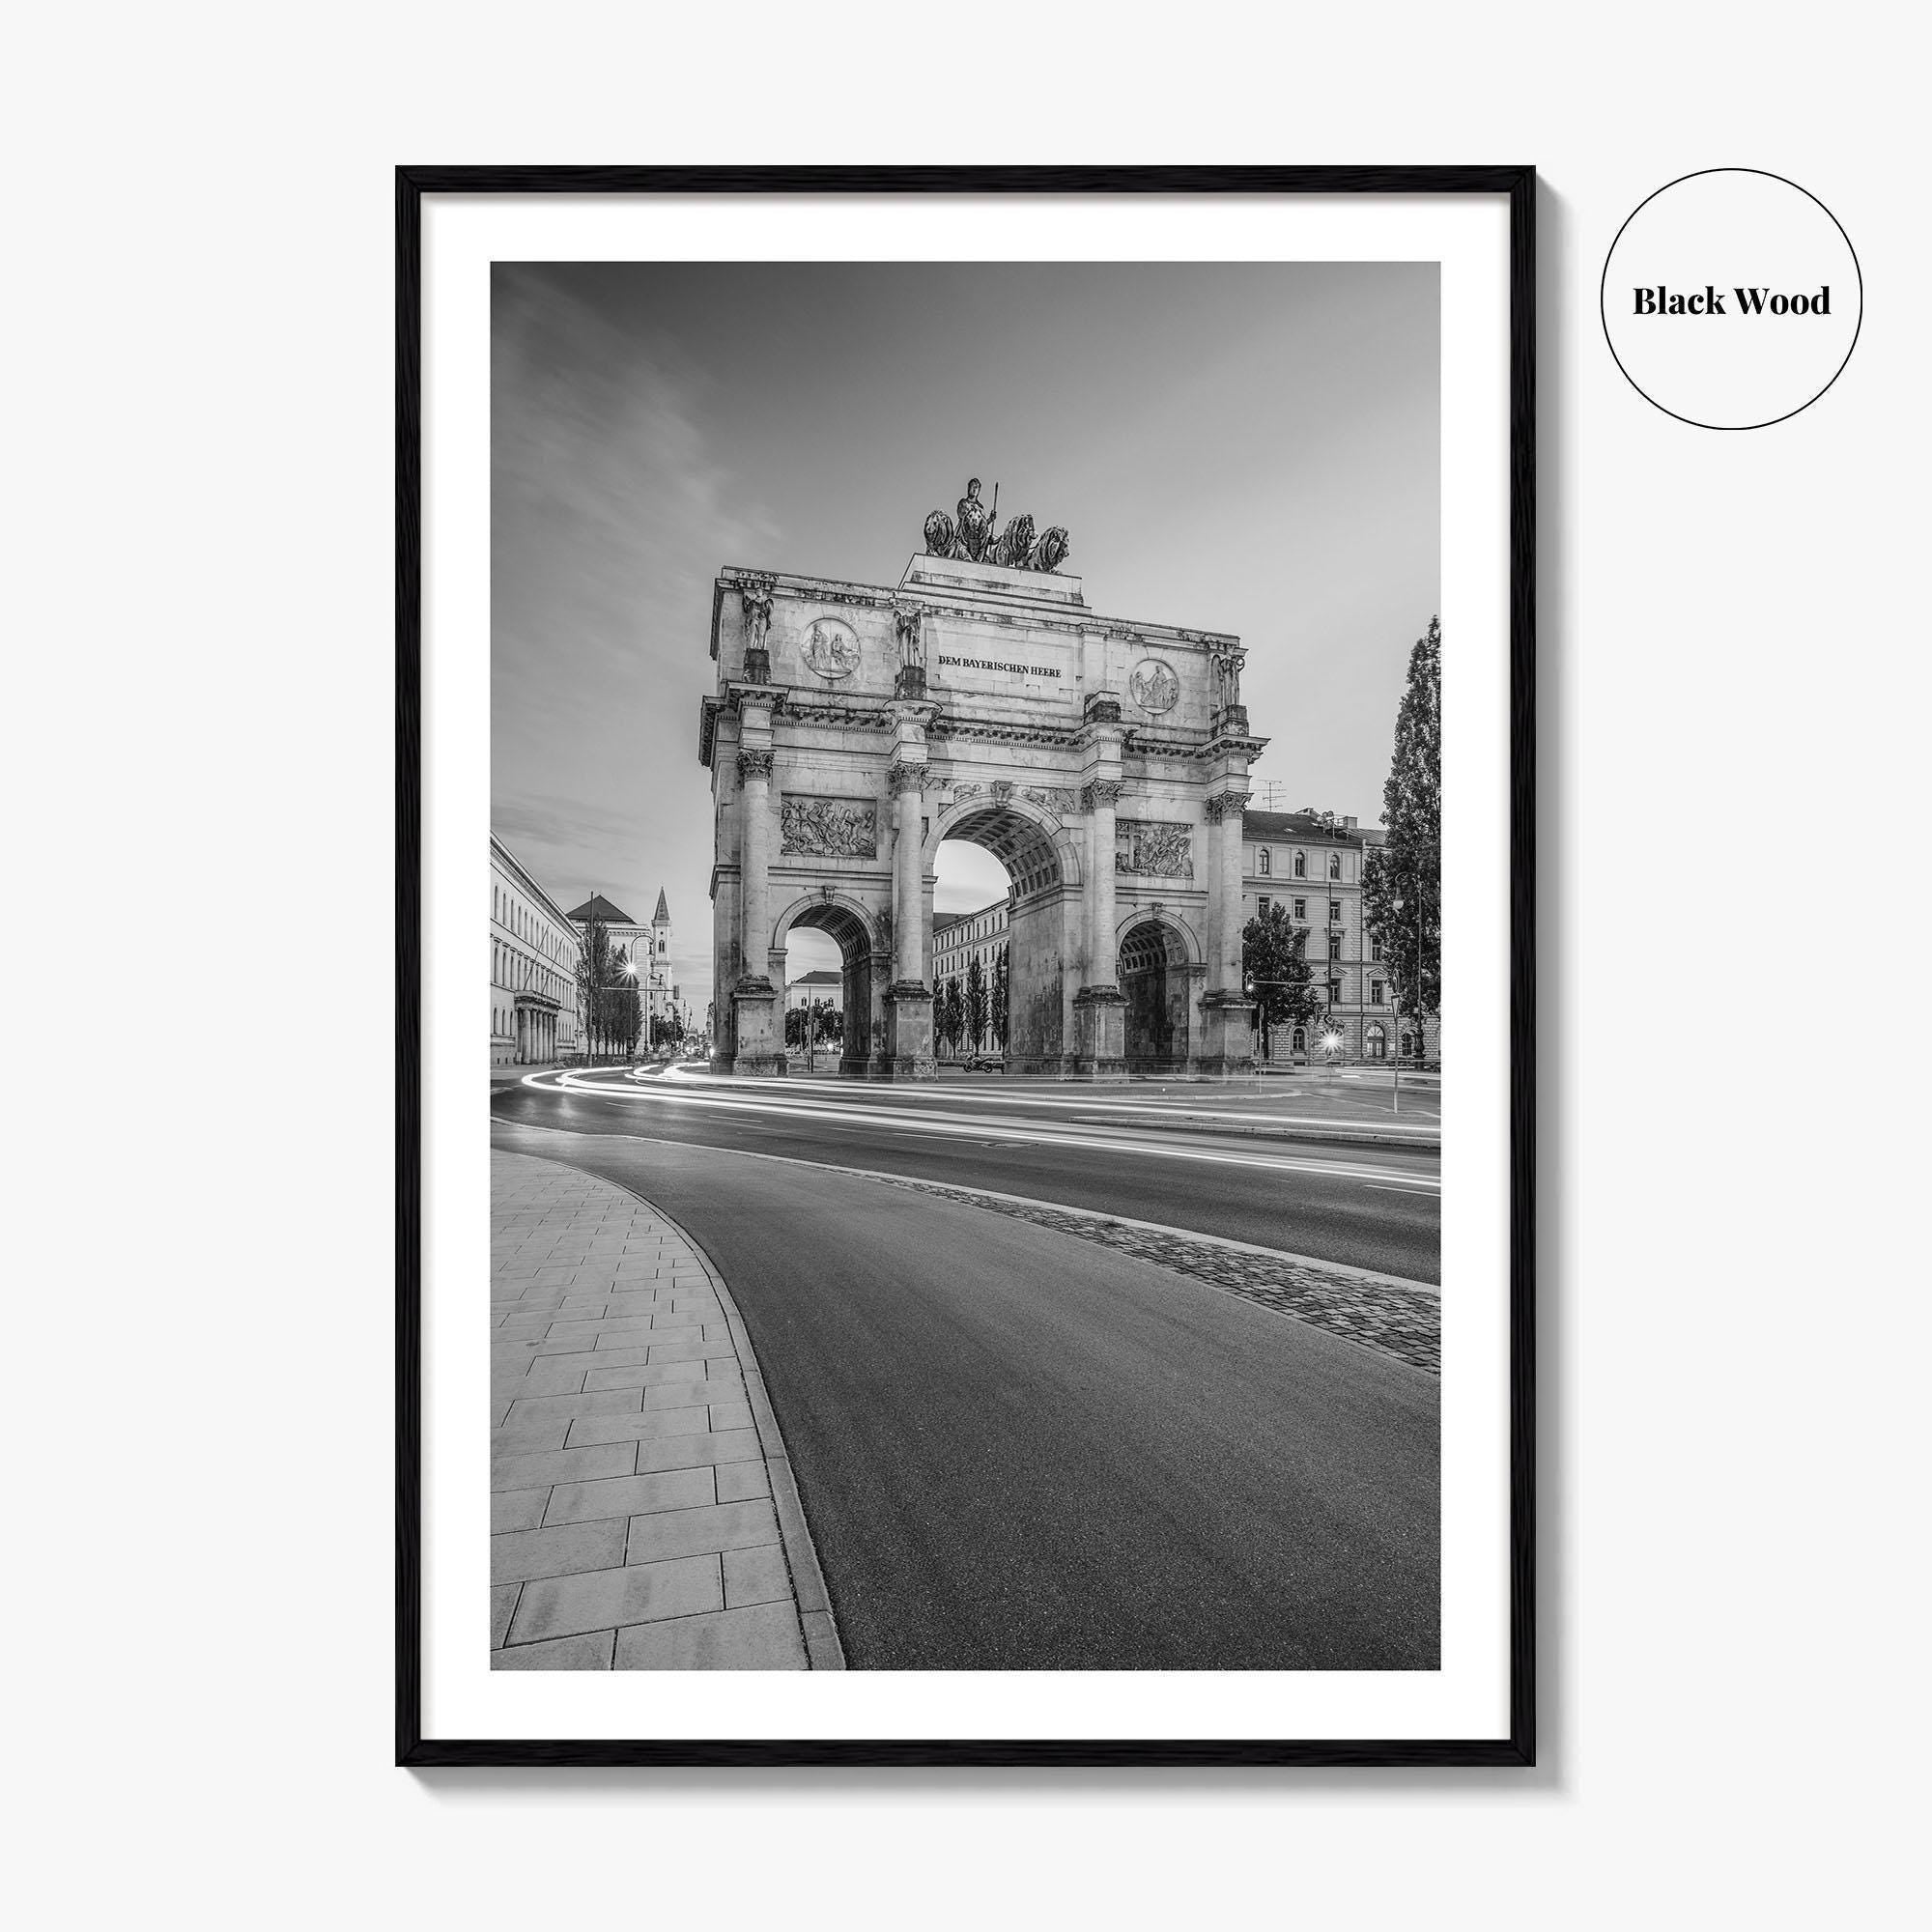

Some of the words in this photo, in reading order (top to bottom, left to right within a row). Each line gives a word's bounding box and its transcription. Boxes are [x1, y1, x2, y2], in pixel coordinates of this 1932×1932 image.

[938, 655, 961, 667] DEM
[963, 658, 1029, 674] BAYERISCHEN
[1031, 667, 1062, 678] HEERE
